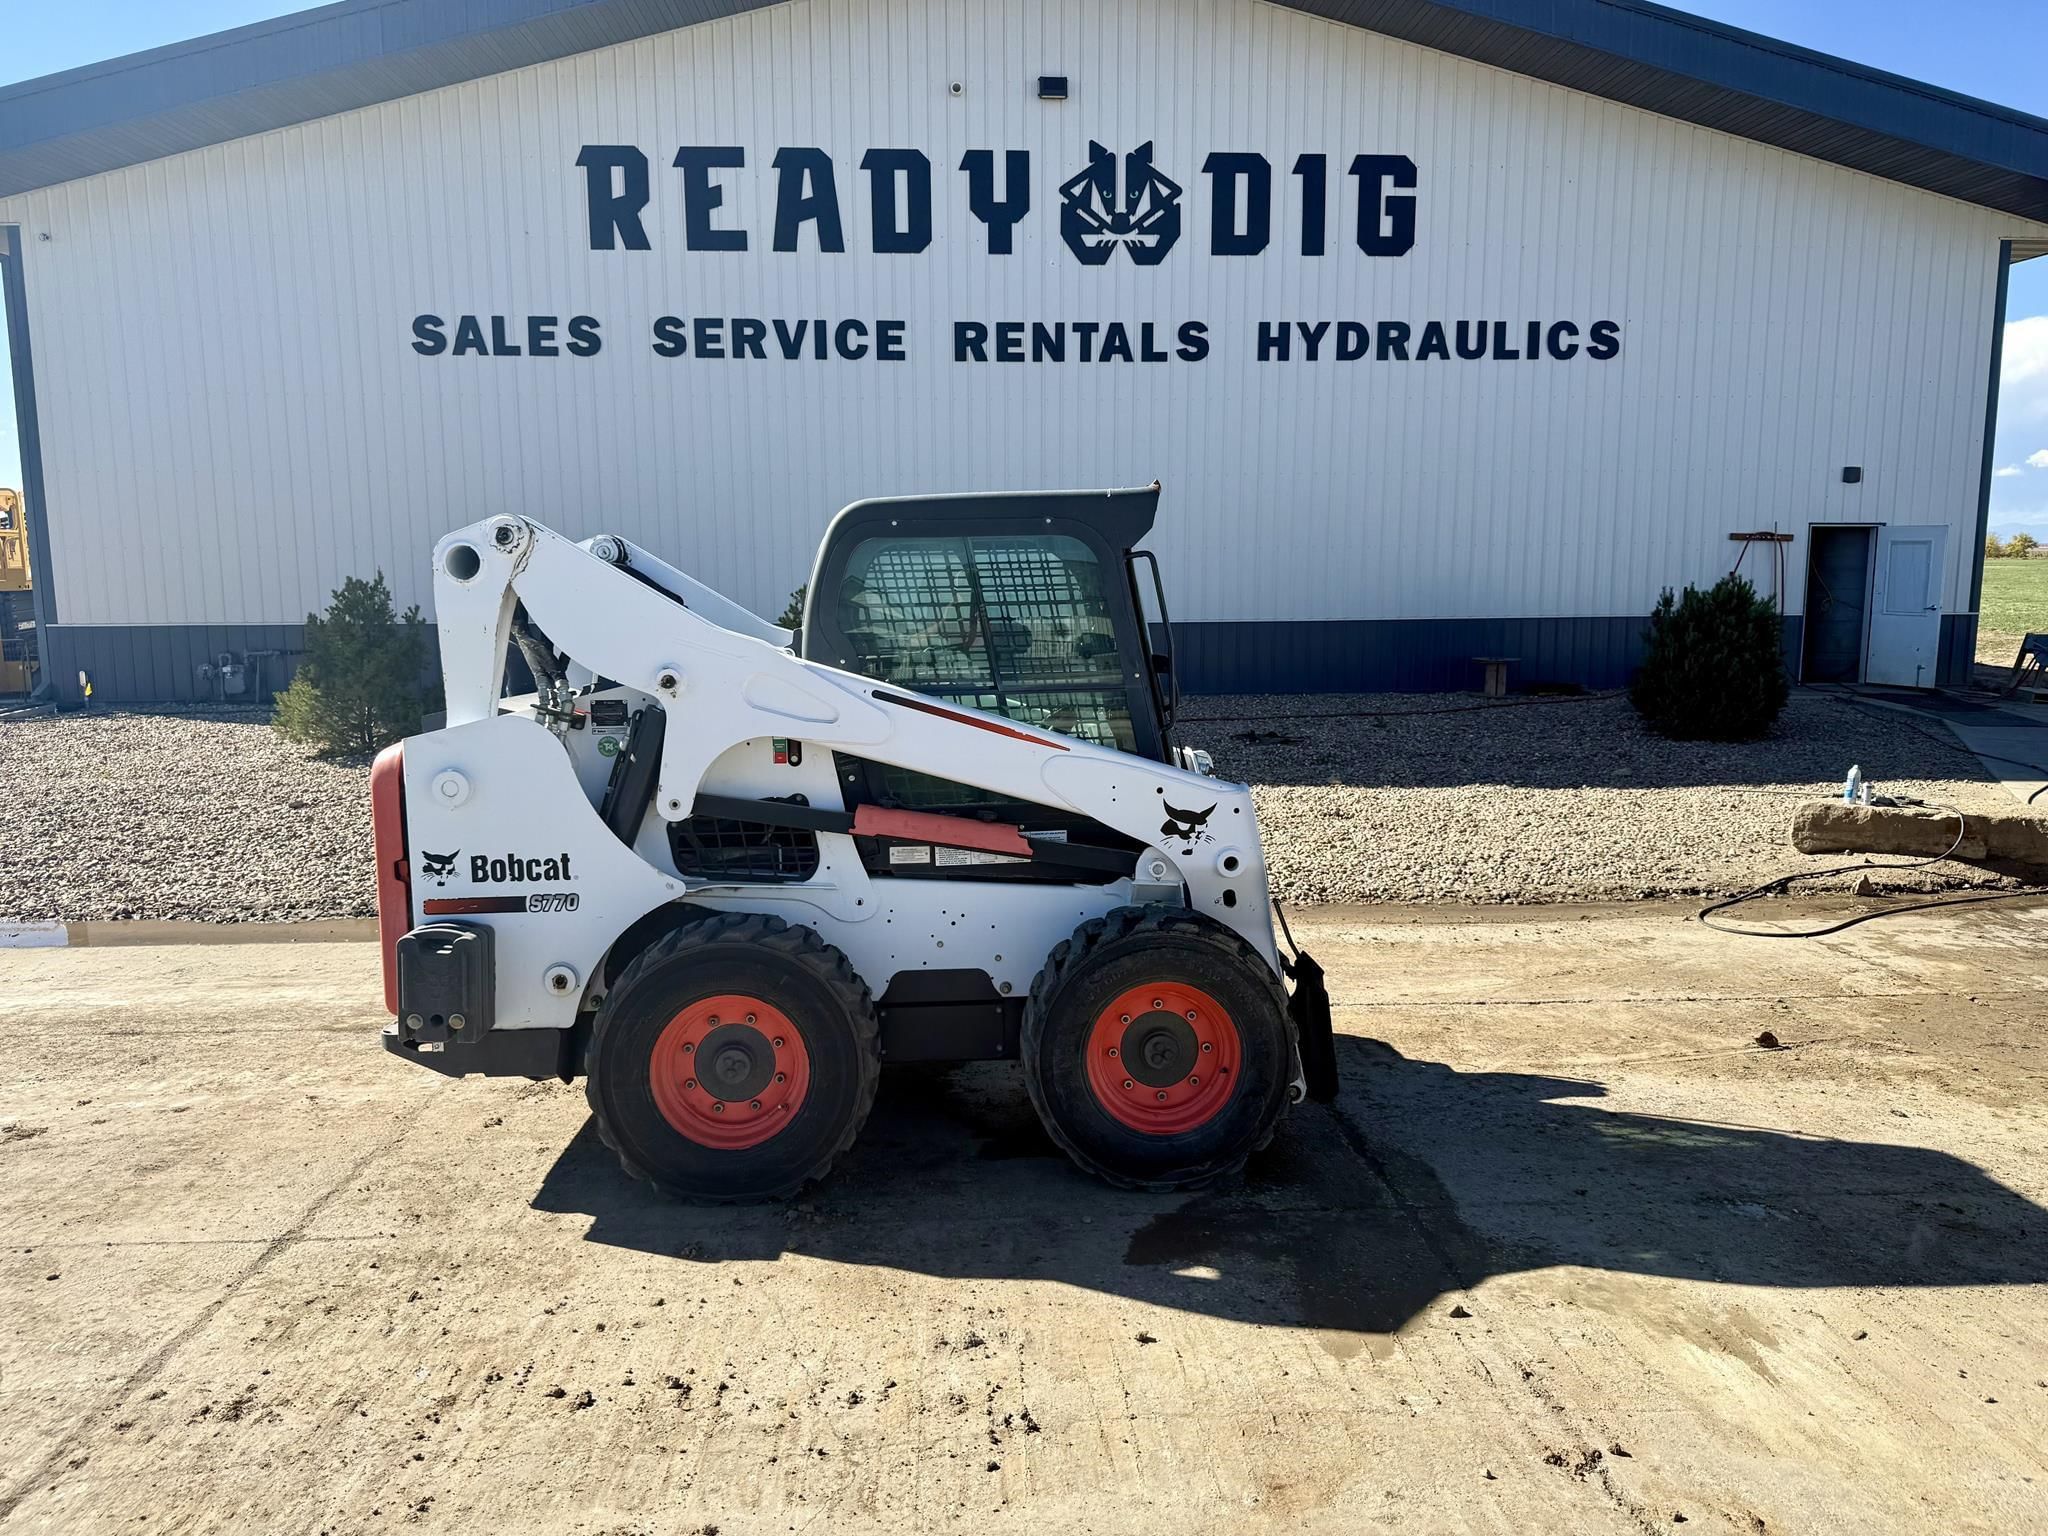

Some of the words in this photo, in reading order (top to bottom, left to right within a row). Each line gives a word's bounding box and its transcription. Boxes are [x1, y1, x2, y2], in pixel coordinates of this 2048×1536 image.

[576, 145, 1030, 255] READY
[1201, 152, 1417, 257] DIG
[412, 315, 601, 357] SALES
[652, 316, 905, 361] SERVICE
[954, 321, 1209, 362] RENTALS
[1257, 320, 1620, 361] HYDRAULICS
[471, 853, 572, 883] Bobcat
[528, 893, 580, 913] S770
